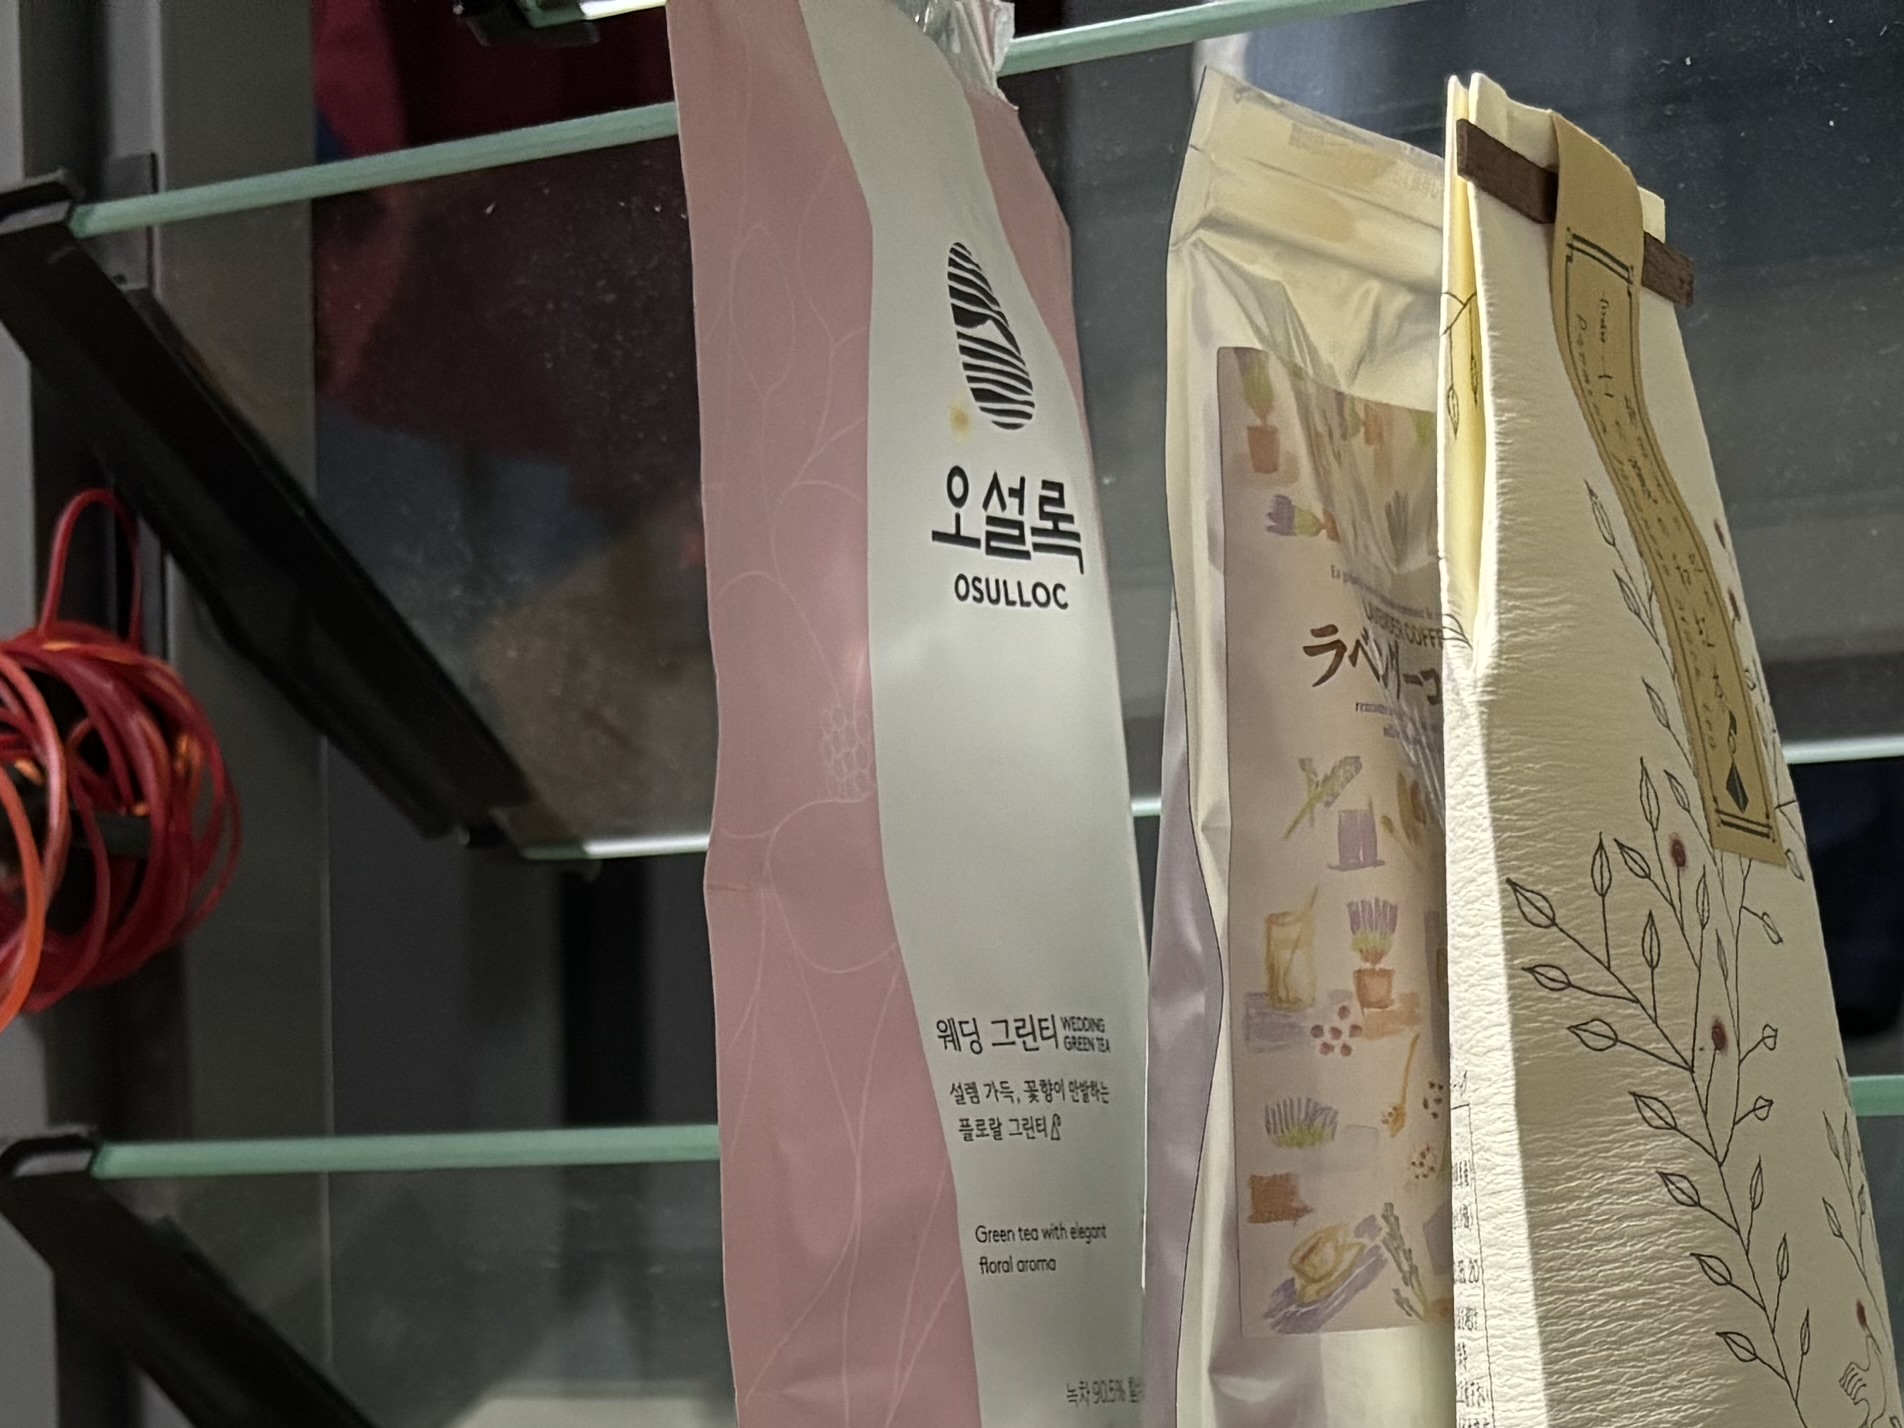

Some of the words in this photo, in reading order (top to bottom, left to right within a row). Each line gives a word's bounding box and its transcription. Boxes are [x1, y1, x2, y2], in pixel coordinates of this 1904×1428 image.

[931, 465, 1085, 575] 오설록
[953, 572, 1070, 610] OSULLOC
[936, 1016, 983, 1055] 웨딩
[990, 1013, 1059, 1052] 그린티
[1060, 1015, 1106, 1034] WEDDING
[1063, 1035, 1095, 1052] GREEN
[949, 1080, 980, 1105] 설렘
[983, 1080, 1021, 1104] 가득,
[1023, 1078, 1065, 1104] 꽃향이
[958, 1117, 1003, 1142] 플로랄
[1008, 1115, 1049, 1140] 그린티
[975, 1225, 1015, 1243] Green
[1018, 1226, 1039, 1241] tea
[1041, 1222, 1068, 1240] with
[1070, 1221, 1107, 1244] elegant
[979, 1256, 1013, 1275] floral
[1016, 1258, 1057, 1273] aroma
